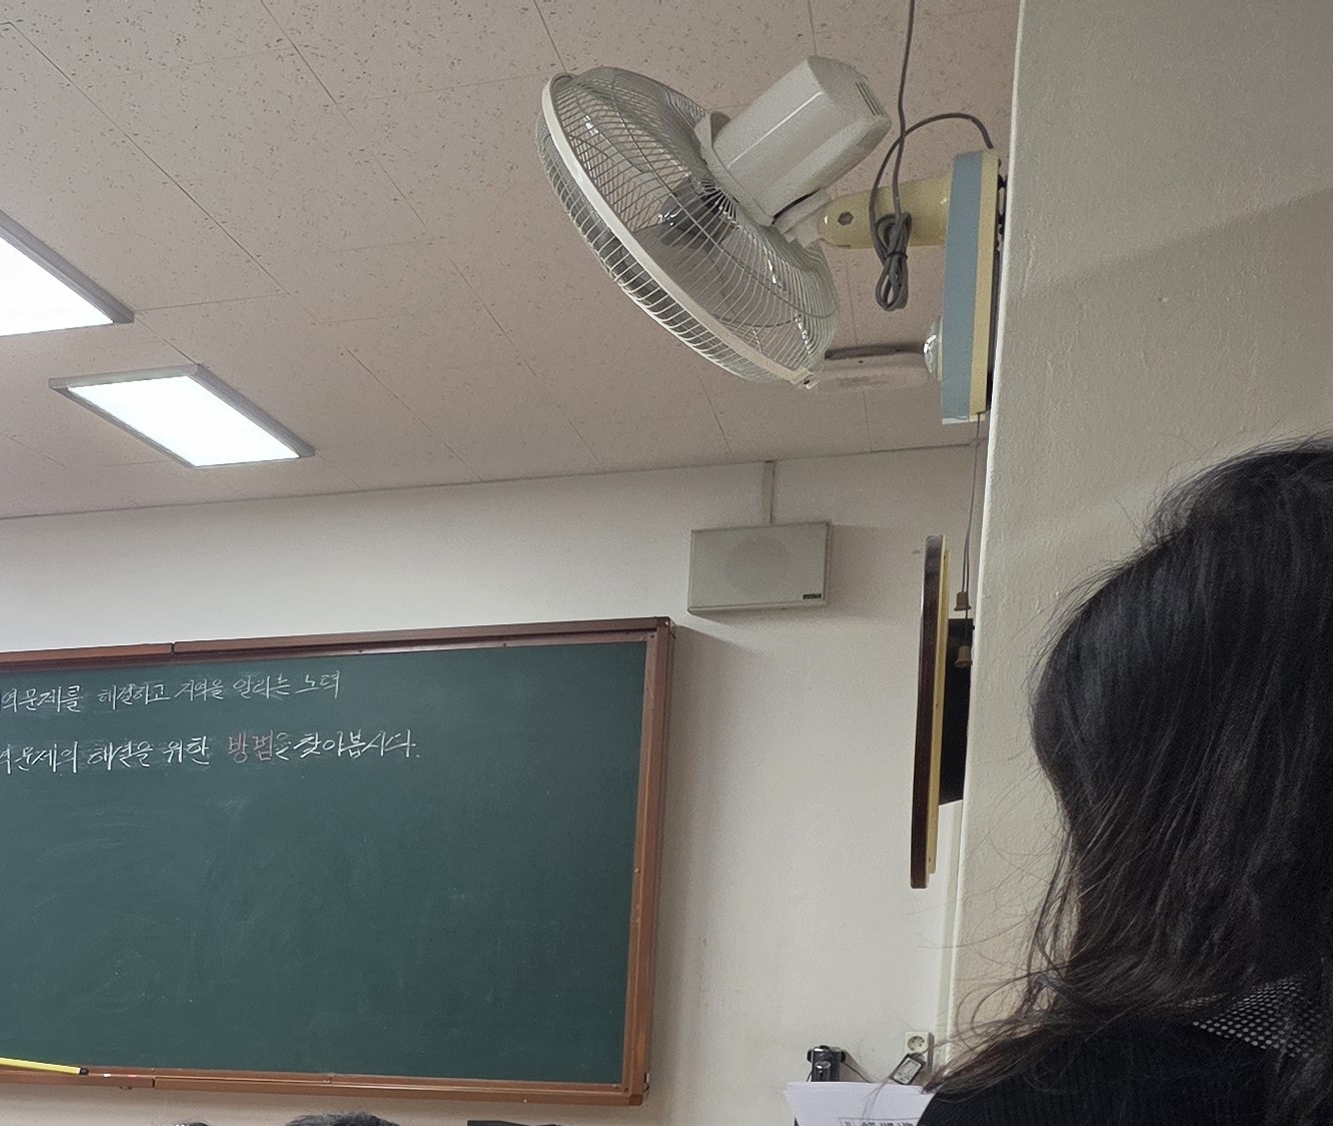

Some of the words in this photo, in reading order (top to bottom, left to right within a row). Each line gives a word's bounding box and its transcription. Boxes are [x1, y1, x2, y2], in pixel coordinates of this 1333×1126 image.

[174, 678, 224, 701] 지역을
[233, 673, 290, 699] 알리는
[295, 670, 340, 699] 노력
[87, 740, 153, 771] 해결을
[163, 735, 209, 765] 위한
[227, 729, 290, 763] 방법을
